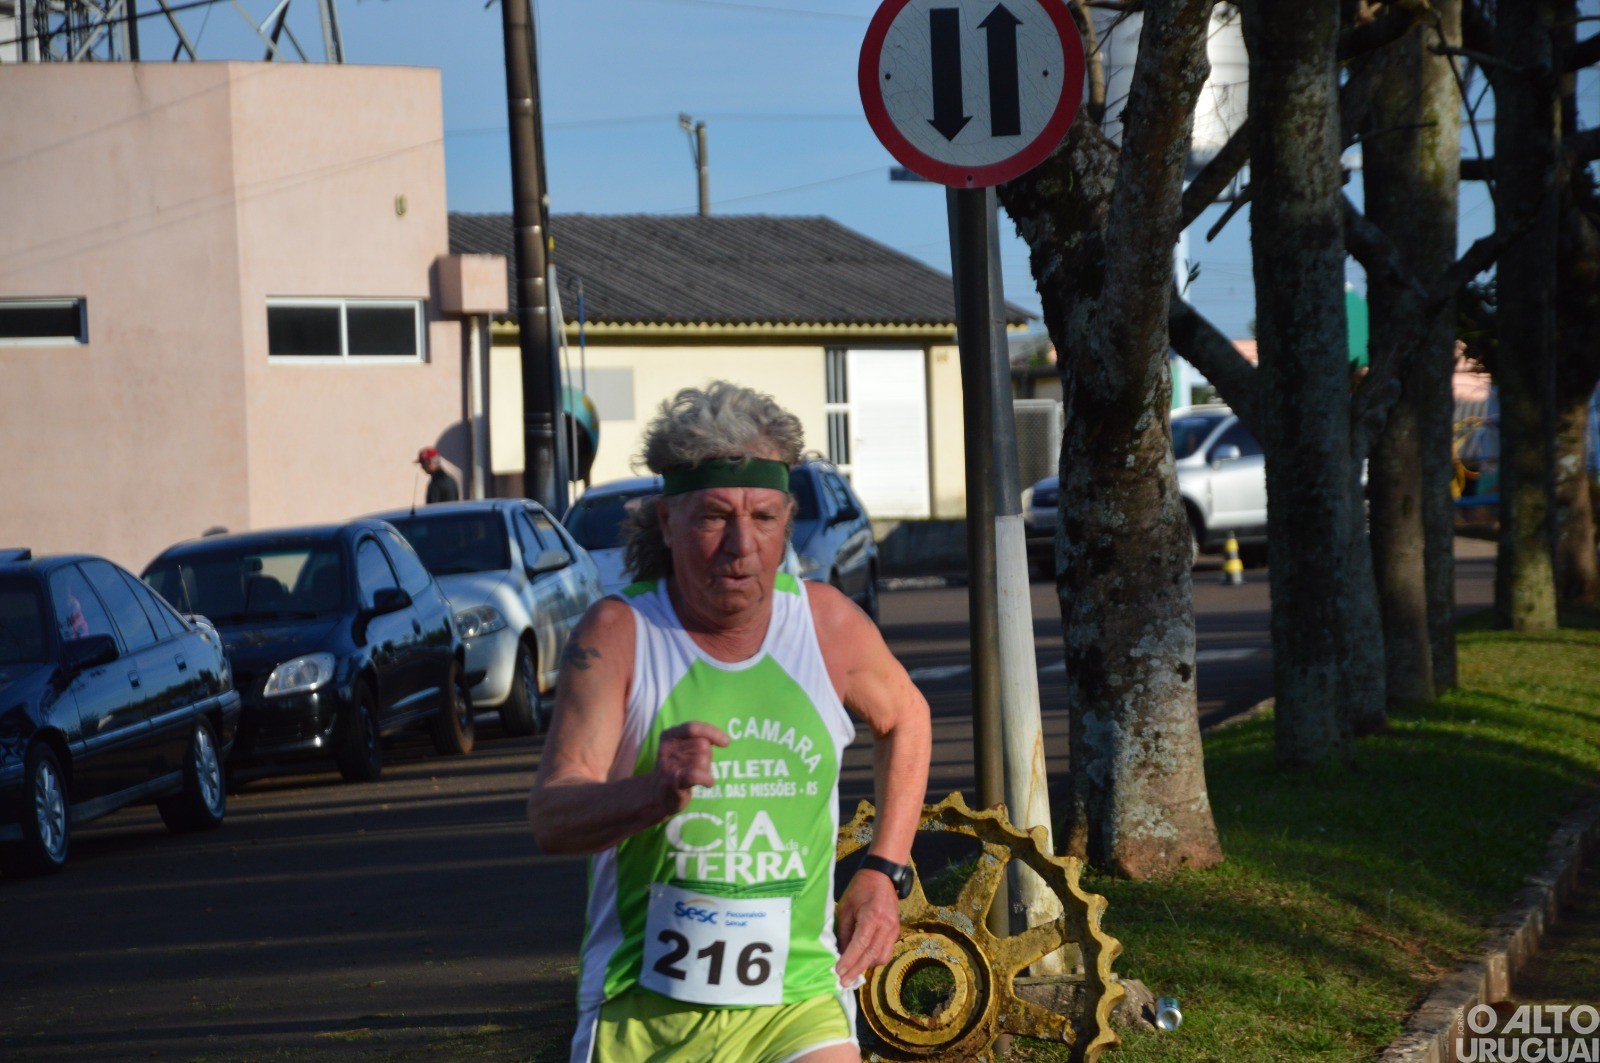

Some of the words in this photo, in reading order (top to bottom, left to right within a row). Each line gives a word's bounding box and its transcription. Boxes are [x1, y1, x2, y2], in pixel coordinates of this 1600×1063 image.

[727, 717, 822, 774] CAMARA
[725, 783, 747, 798] DAS
[750, 779, 797, 798] MISSÕES
[806, 781, 818, 795] RS
[665, 810, 786, 852] CIA
[667, 851, 807, 884] TERRA
[652, 928, 774, 987] 216
